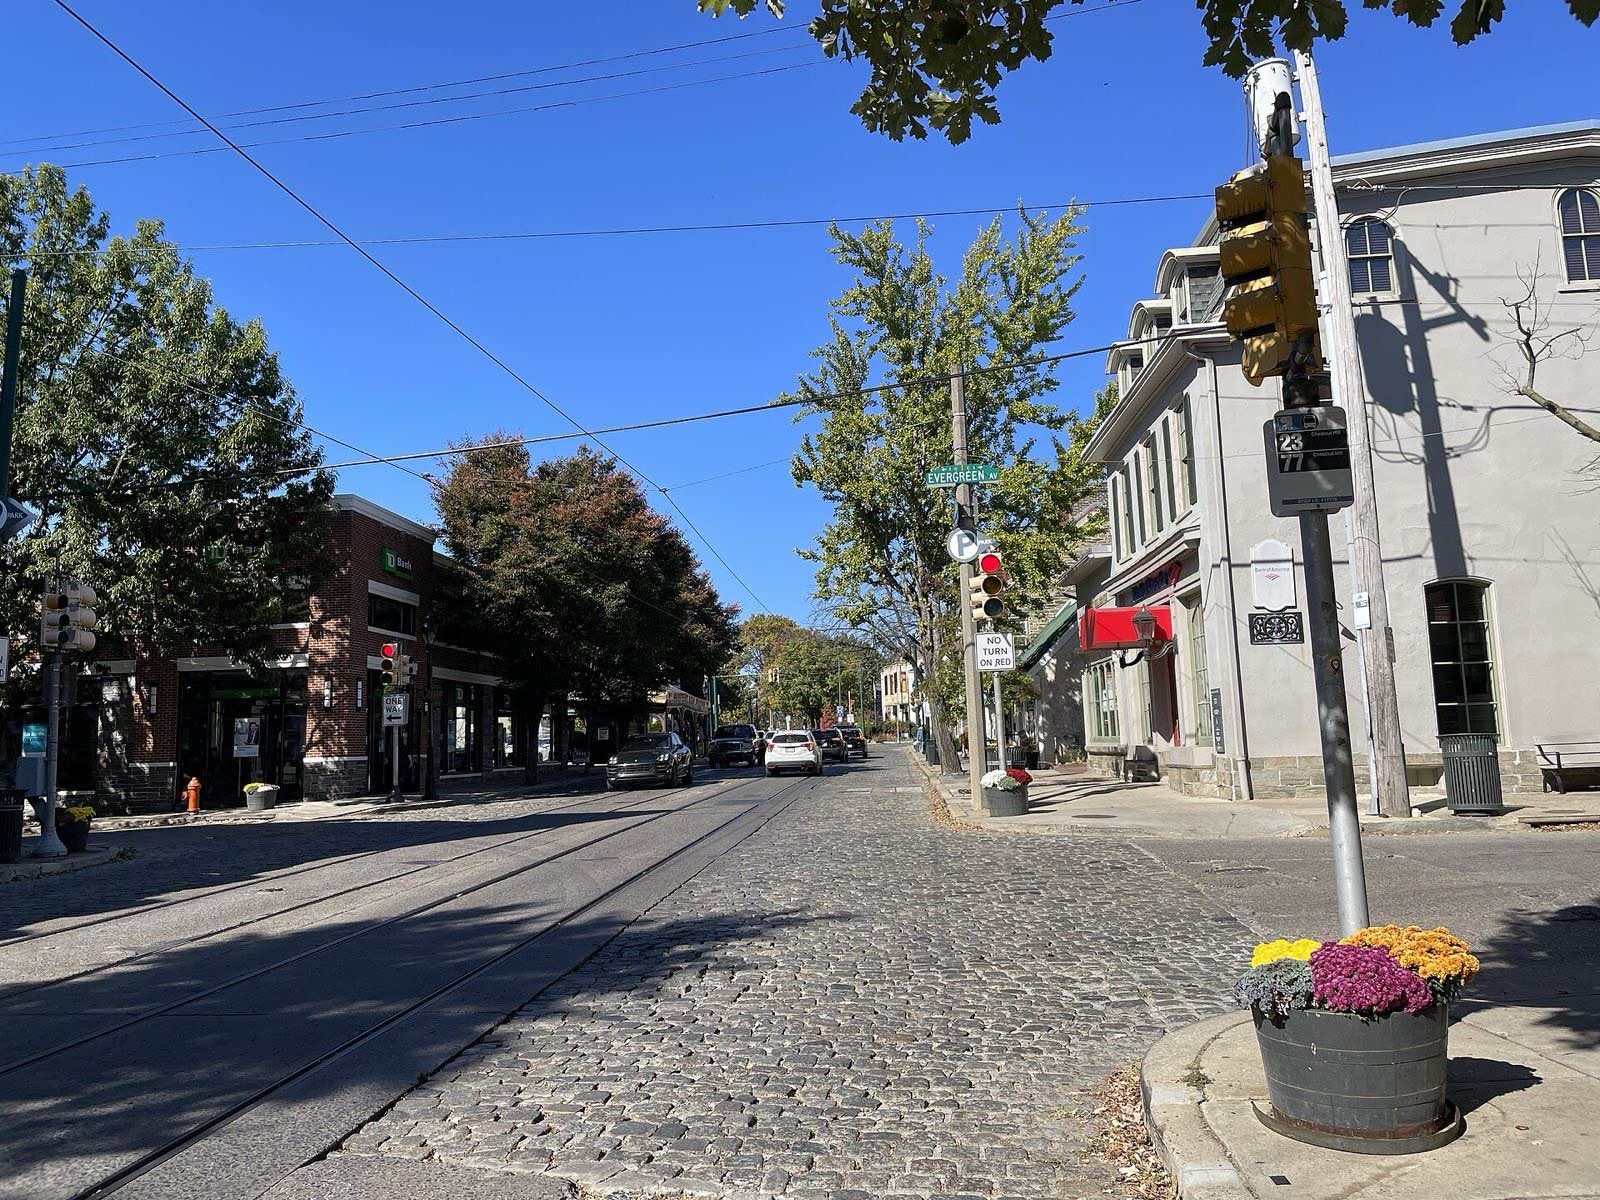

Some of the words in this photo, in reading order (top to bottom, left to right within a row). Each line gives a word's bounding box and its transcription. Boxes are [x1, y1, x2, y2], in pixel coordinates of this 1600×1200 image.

[1279, 433, 1303, 451] 23
[1280, 452, 1303, 471] 77
[928, 470, 985, 484] EVERGREEN
[988, 472, 998, 480] AV
[987, 636, 1001, 645] NO
[983, 647, 1008, 656] TURN
[980, 658, 992, 667] ON
[995, 657, 1011, 667] RED
[385, 697, 403, 705] ONE
[385, 705, 403, 713] WAY
